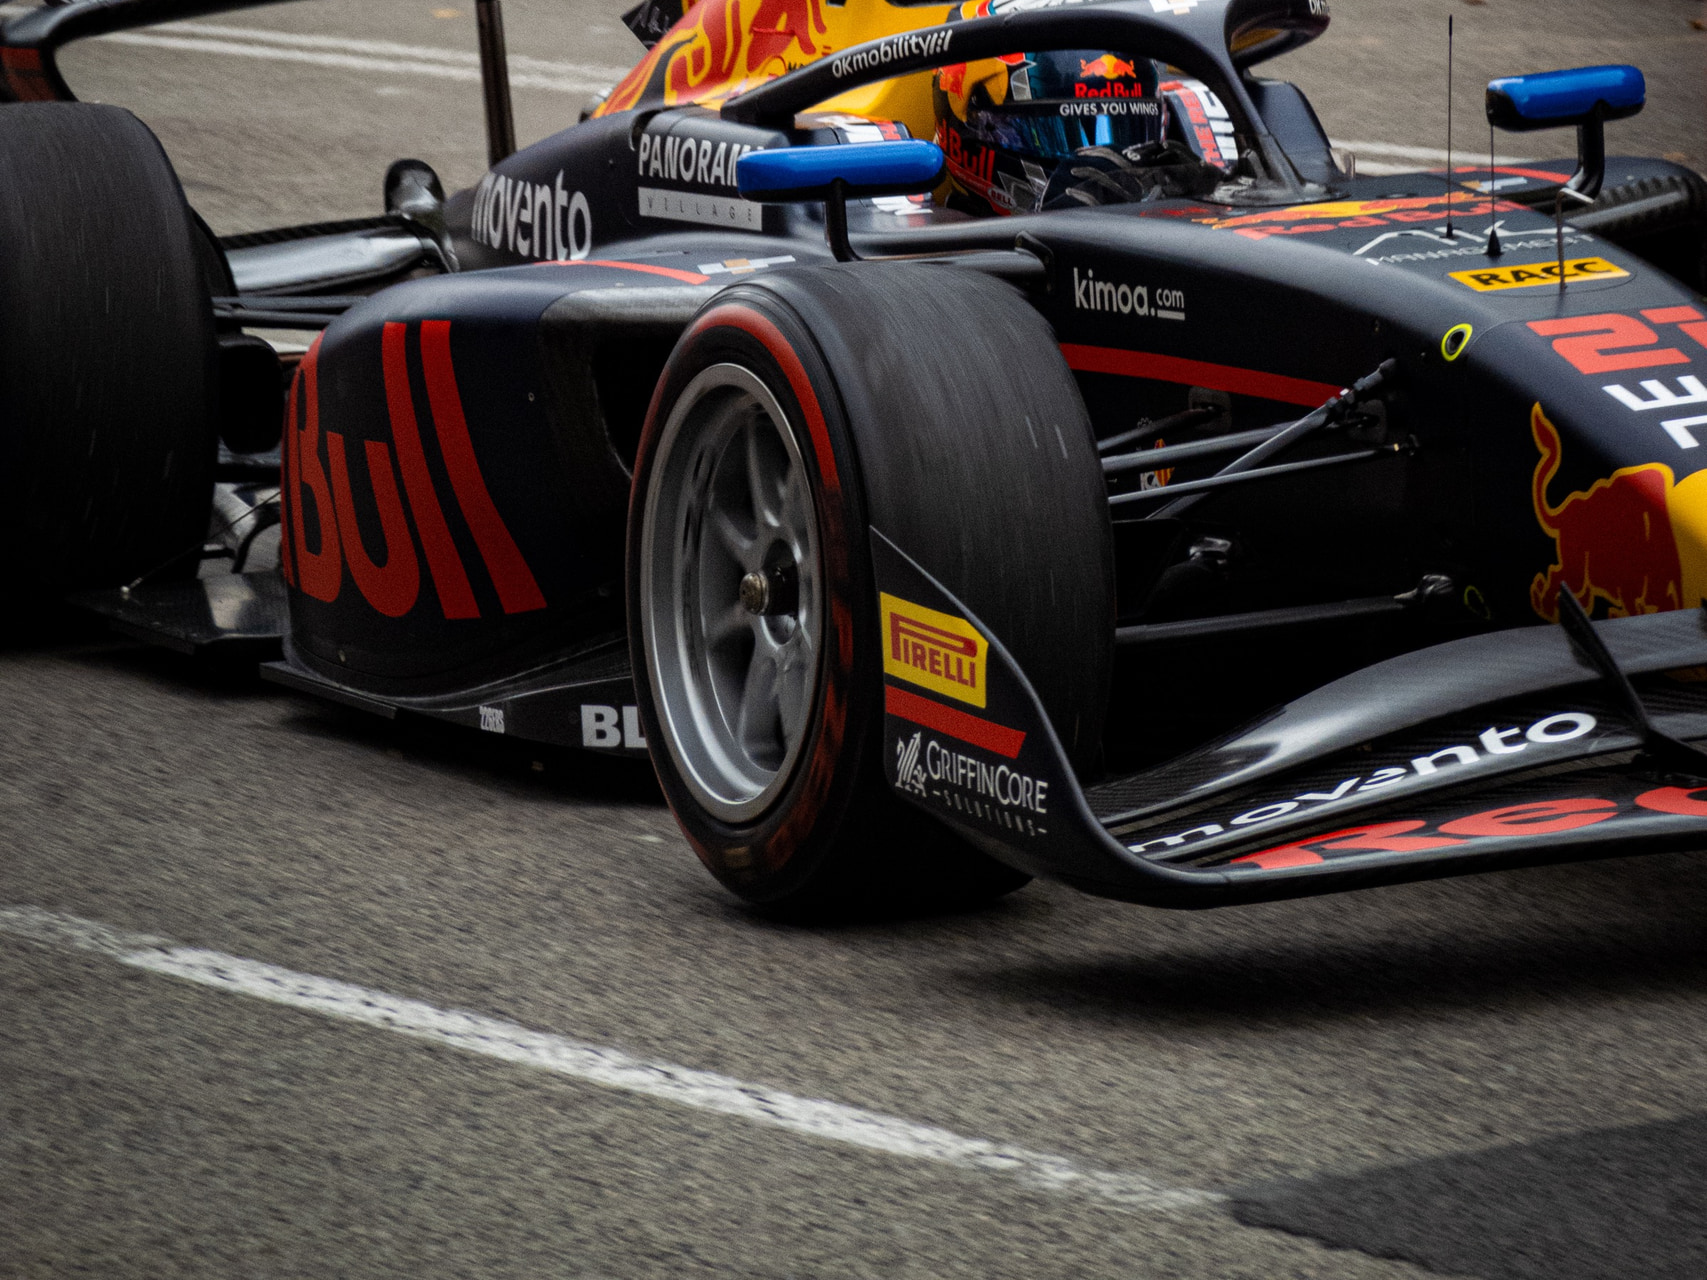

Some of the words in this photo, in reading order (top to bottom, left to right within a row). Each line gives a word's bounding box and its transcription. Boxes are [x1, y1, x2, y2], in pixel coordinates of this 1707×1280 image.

[1059, 102, 1098, 117] GIVES
[1100, 101, 1128, 116] YOU
[1129, 101, 1160, 117] WINGS
[1074, 81, 1112, 98] Red
[638, 133, 766, 188] PANORAM
[471, 168, 593, 261] movento
[1073, 266, 1185, 317] kimoa.com
[1468, 260, 1612, 288] RACC
[289, 319, 548, 619] Bull
[889, 611, 978, 688] PIRELLI
[1128, 711, 1598, 854] movento
